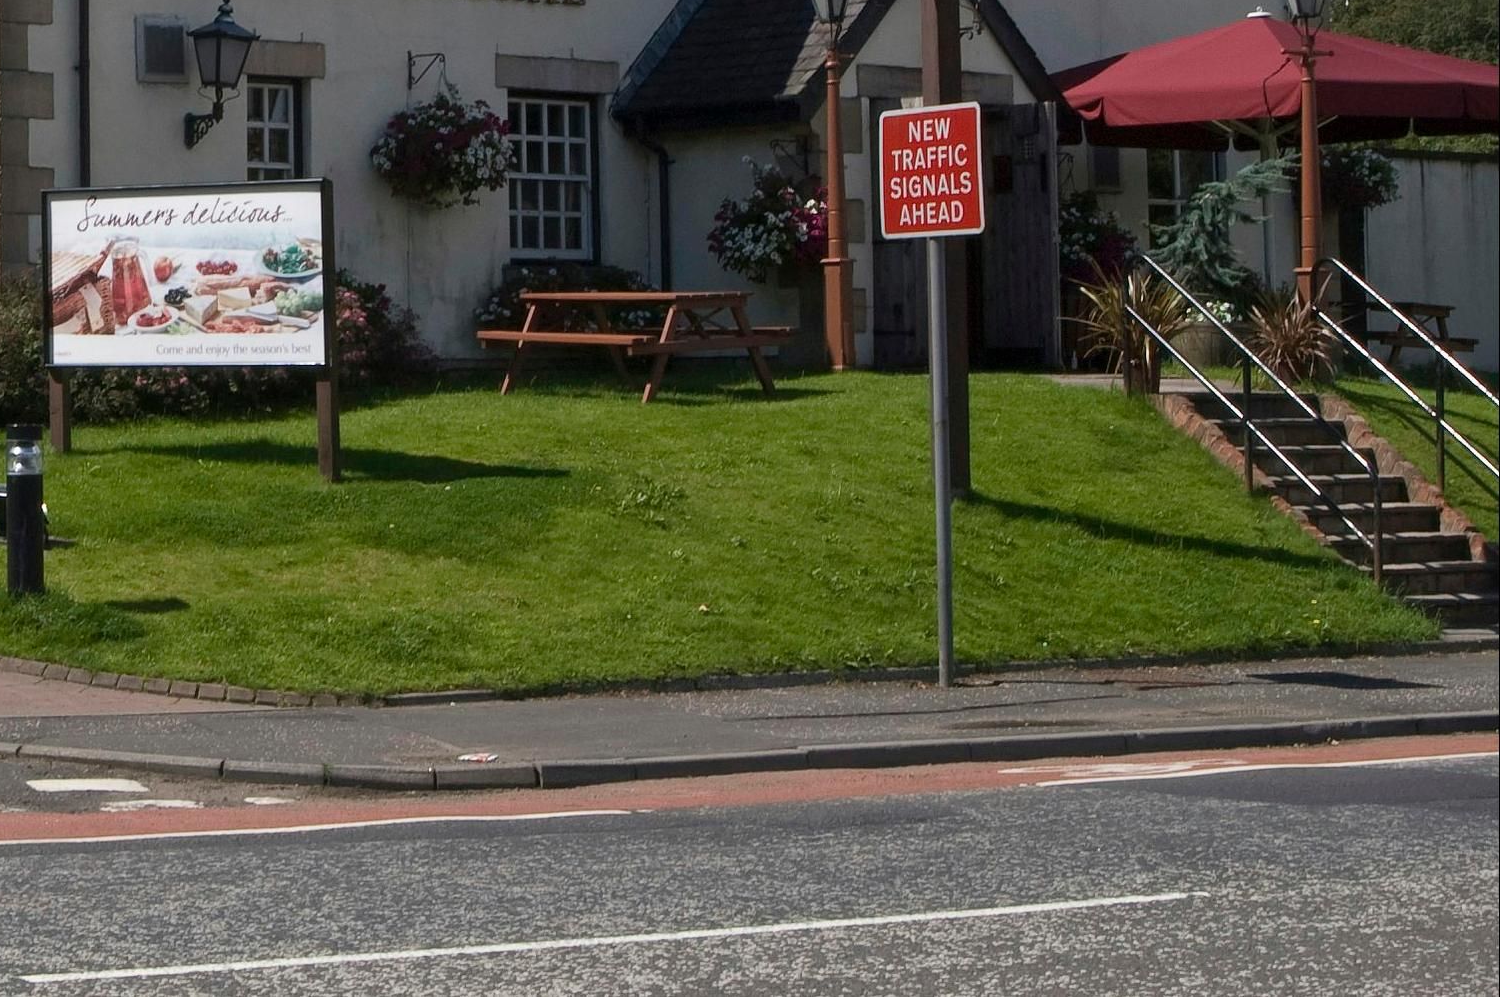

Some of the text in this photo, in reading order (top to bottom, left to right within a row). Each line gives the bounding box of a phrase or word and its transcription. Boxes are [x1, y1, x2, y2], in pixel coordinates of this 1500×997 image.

[908, 117, 950, 143] NEW
[891, 143, 968, 171] TRAFFIC
[890, 171, 972, 199] SIGNALS
[899, 200, 964, 226] AHEAD
[155, 344, 183, 355] Come
[186, 343, 203, 354] and
[205, 344, 230, 357] enjoy
[233, 343, 248, 354] the
[291, 343, 311, 353] best
